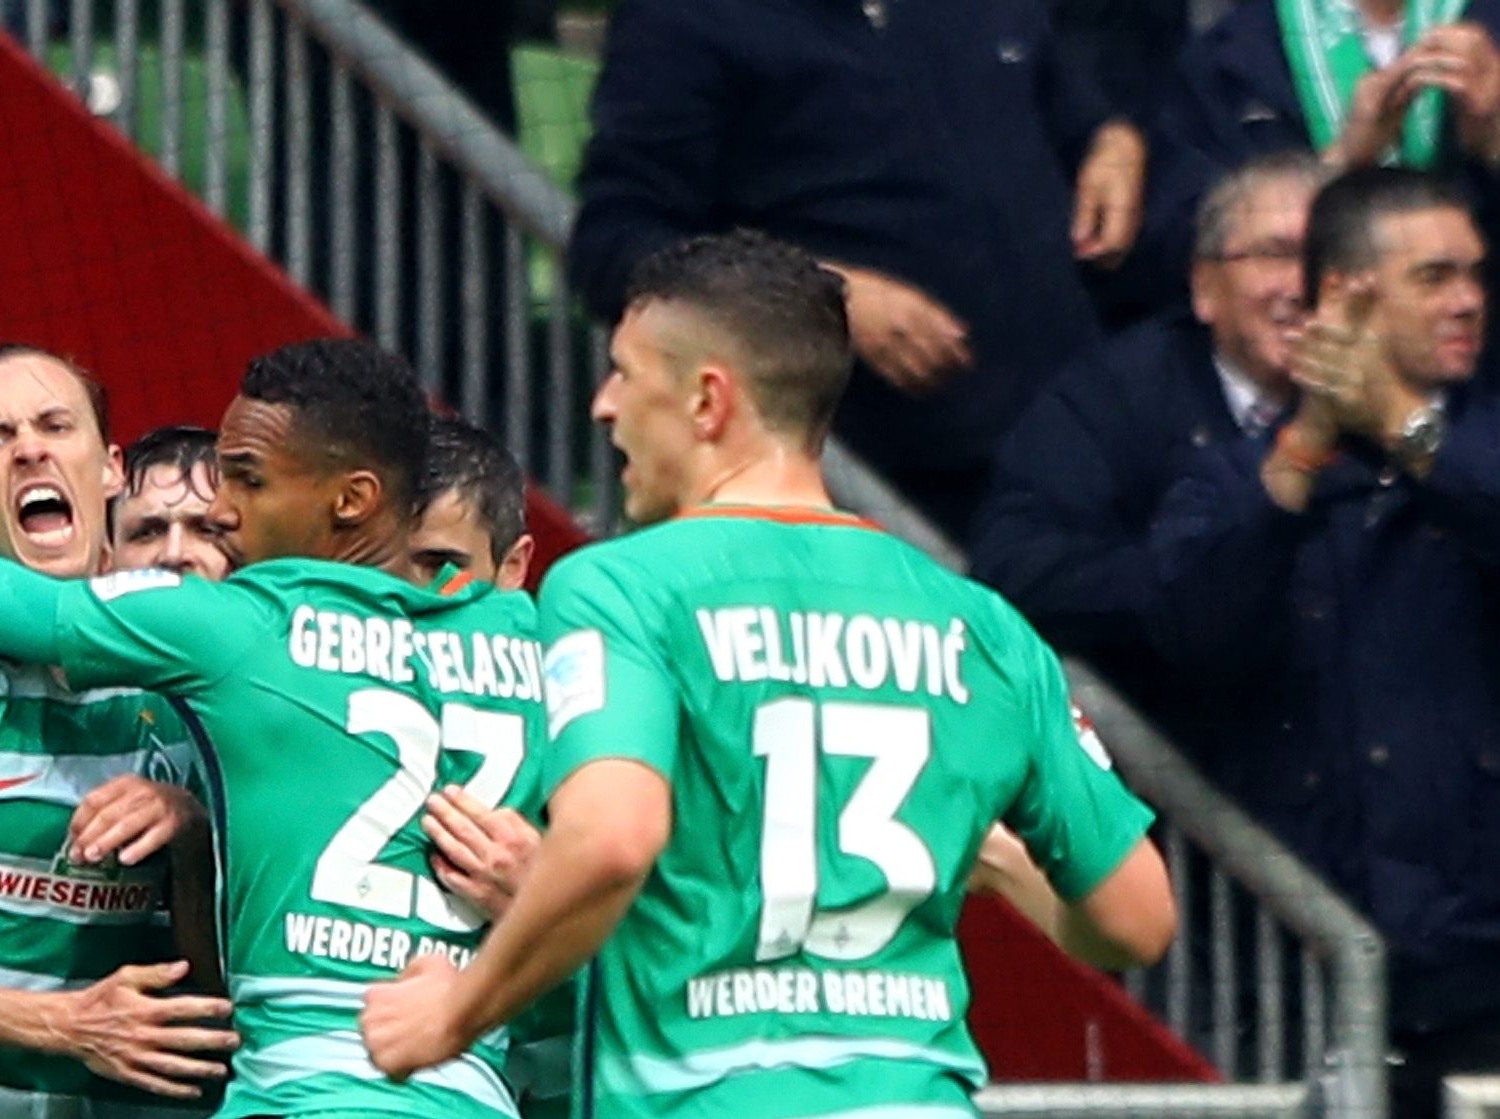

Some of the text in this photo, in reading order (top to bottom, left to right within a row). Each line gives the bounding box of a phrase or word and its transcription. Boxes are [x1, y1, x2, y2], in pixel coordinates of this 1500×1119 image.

[697, 607, 968, 704] VELJKOVIĆ
[753, 698, 936, 961] 13
[286, 912, 411, 970] WERDER
[688, 969, 951, 1022] WERDER BREMEN
